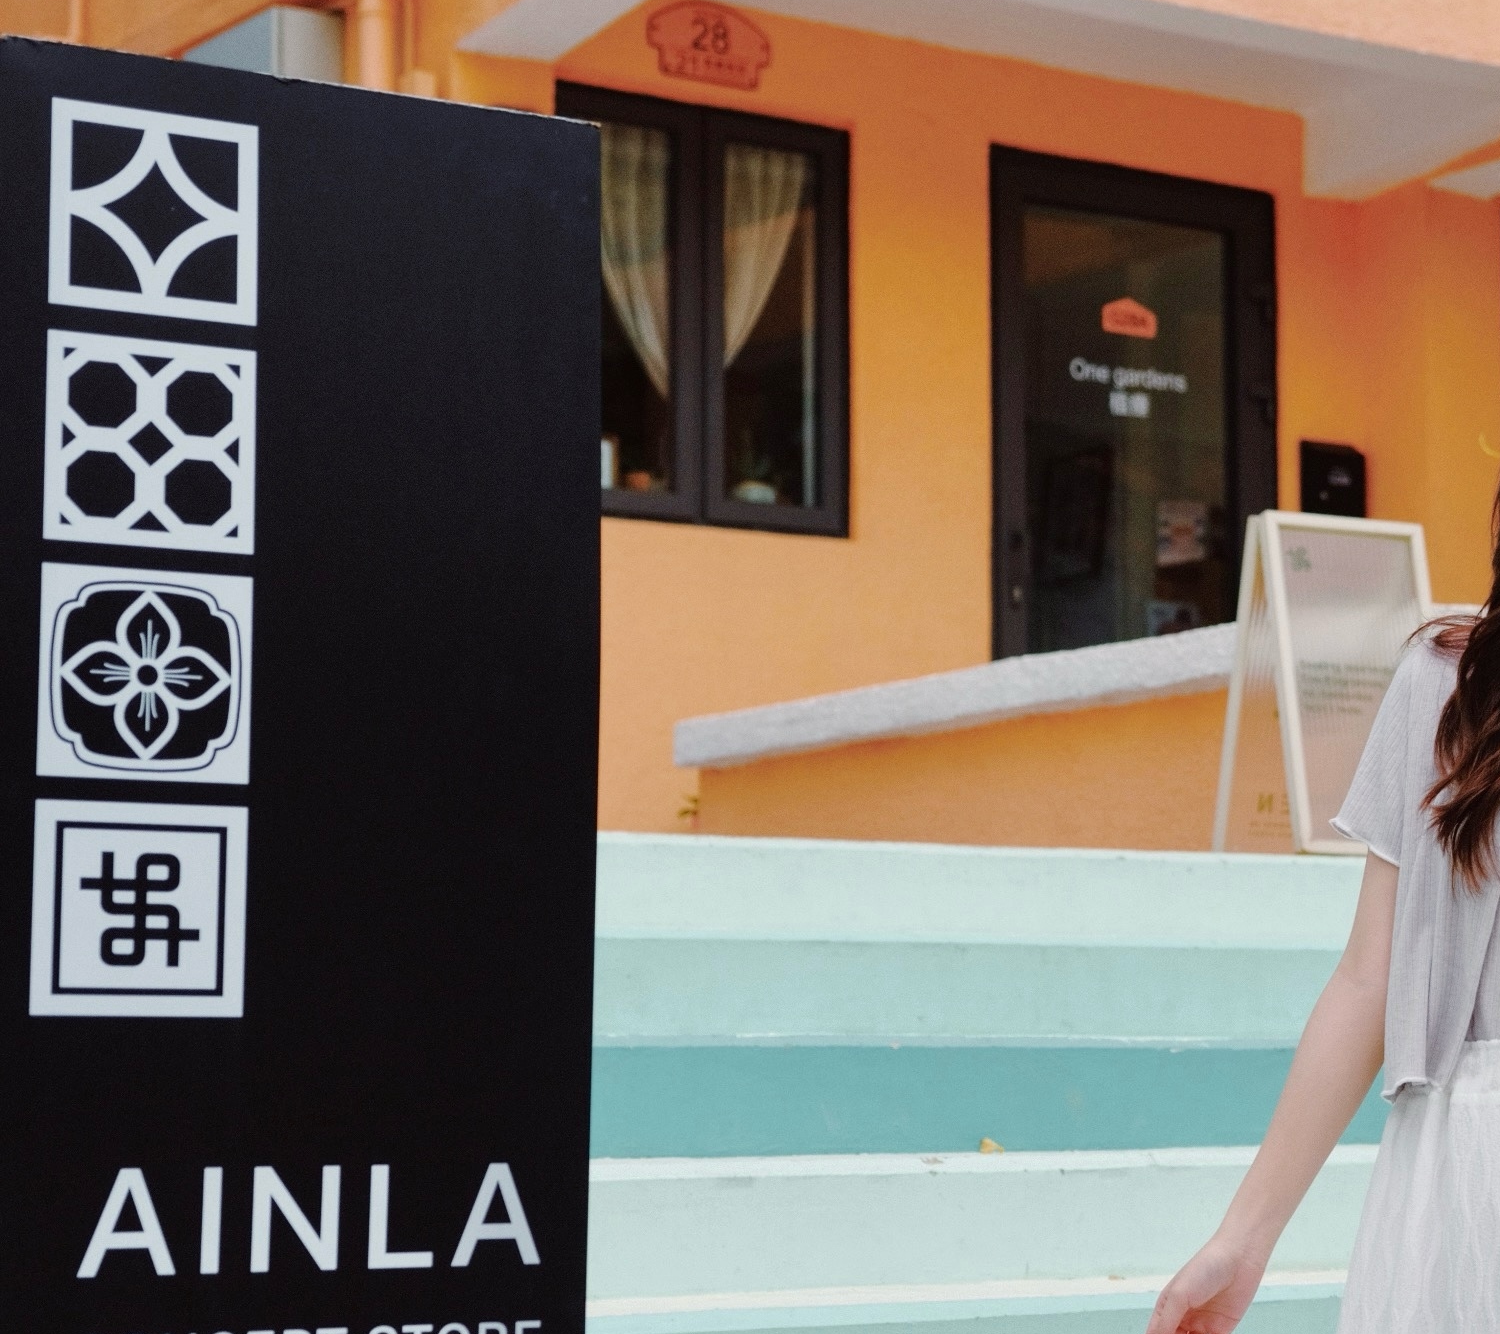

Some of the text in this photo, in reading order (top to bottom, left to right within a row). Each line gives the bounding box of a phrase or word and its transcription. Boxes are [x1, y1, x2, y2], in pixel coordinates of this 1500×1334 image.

[691, 17, 730, 55] 28
[1069, 357, 1188, 395] One gardens
[76, 1162, 541, 1279] AINLA
